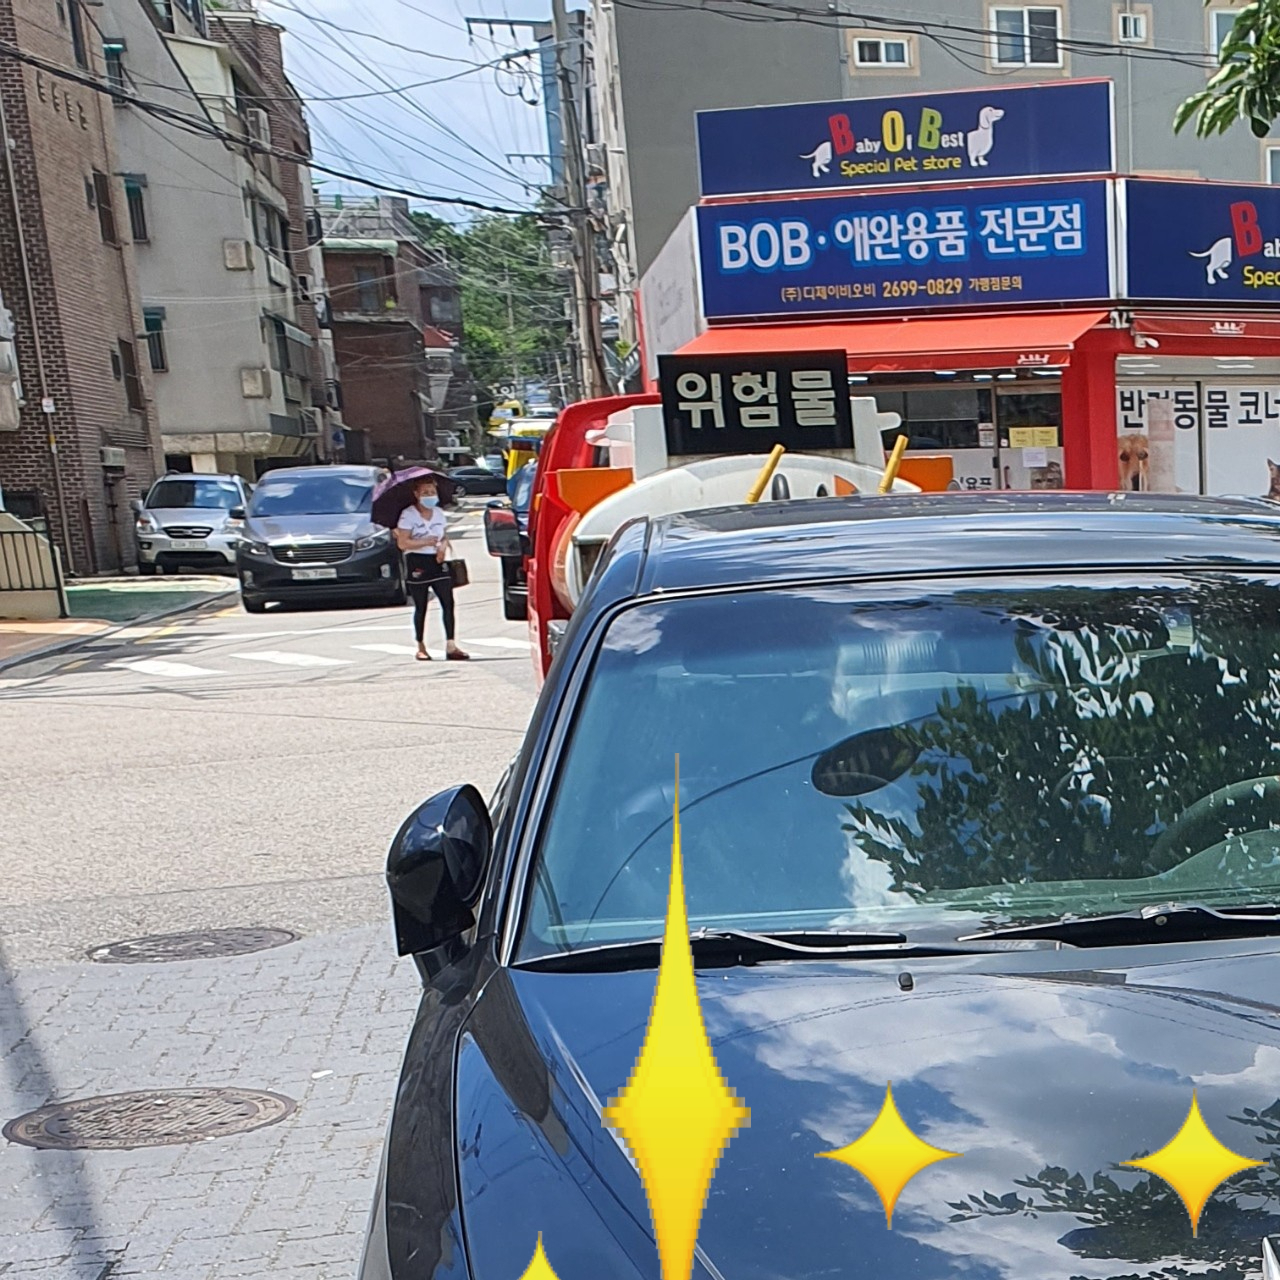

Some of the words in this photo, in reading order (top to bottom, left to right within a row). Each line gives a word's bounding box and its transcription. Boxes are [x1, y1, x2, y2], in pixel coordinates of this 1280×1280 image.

[828, 114, 881, 156] Baby
[882, 110, 912, 152] Of
[918, 107, 964, 150] Best
[840, 158, 890, 177] Special
[894, 156, 918, 172] Pet
[922, 155, 962, 171] store
[834, 210, 968, 262] 애완용품
[980, 203, 1082, 253] 전문점
[882, 278, 963, 298] 2699-0829
[676, 370, 837, 429] 위험물
